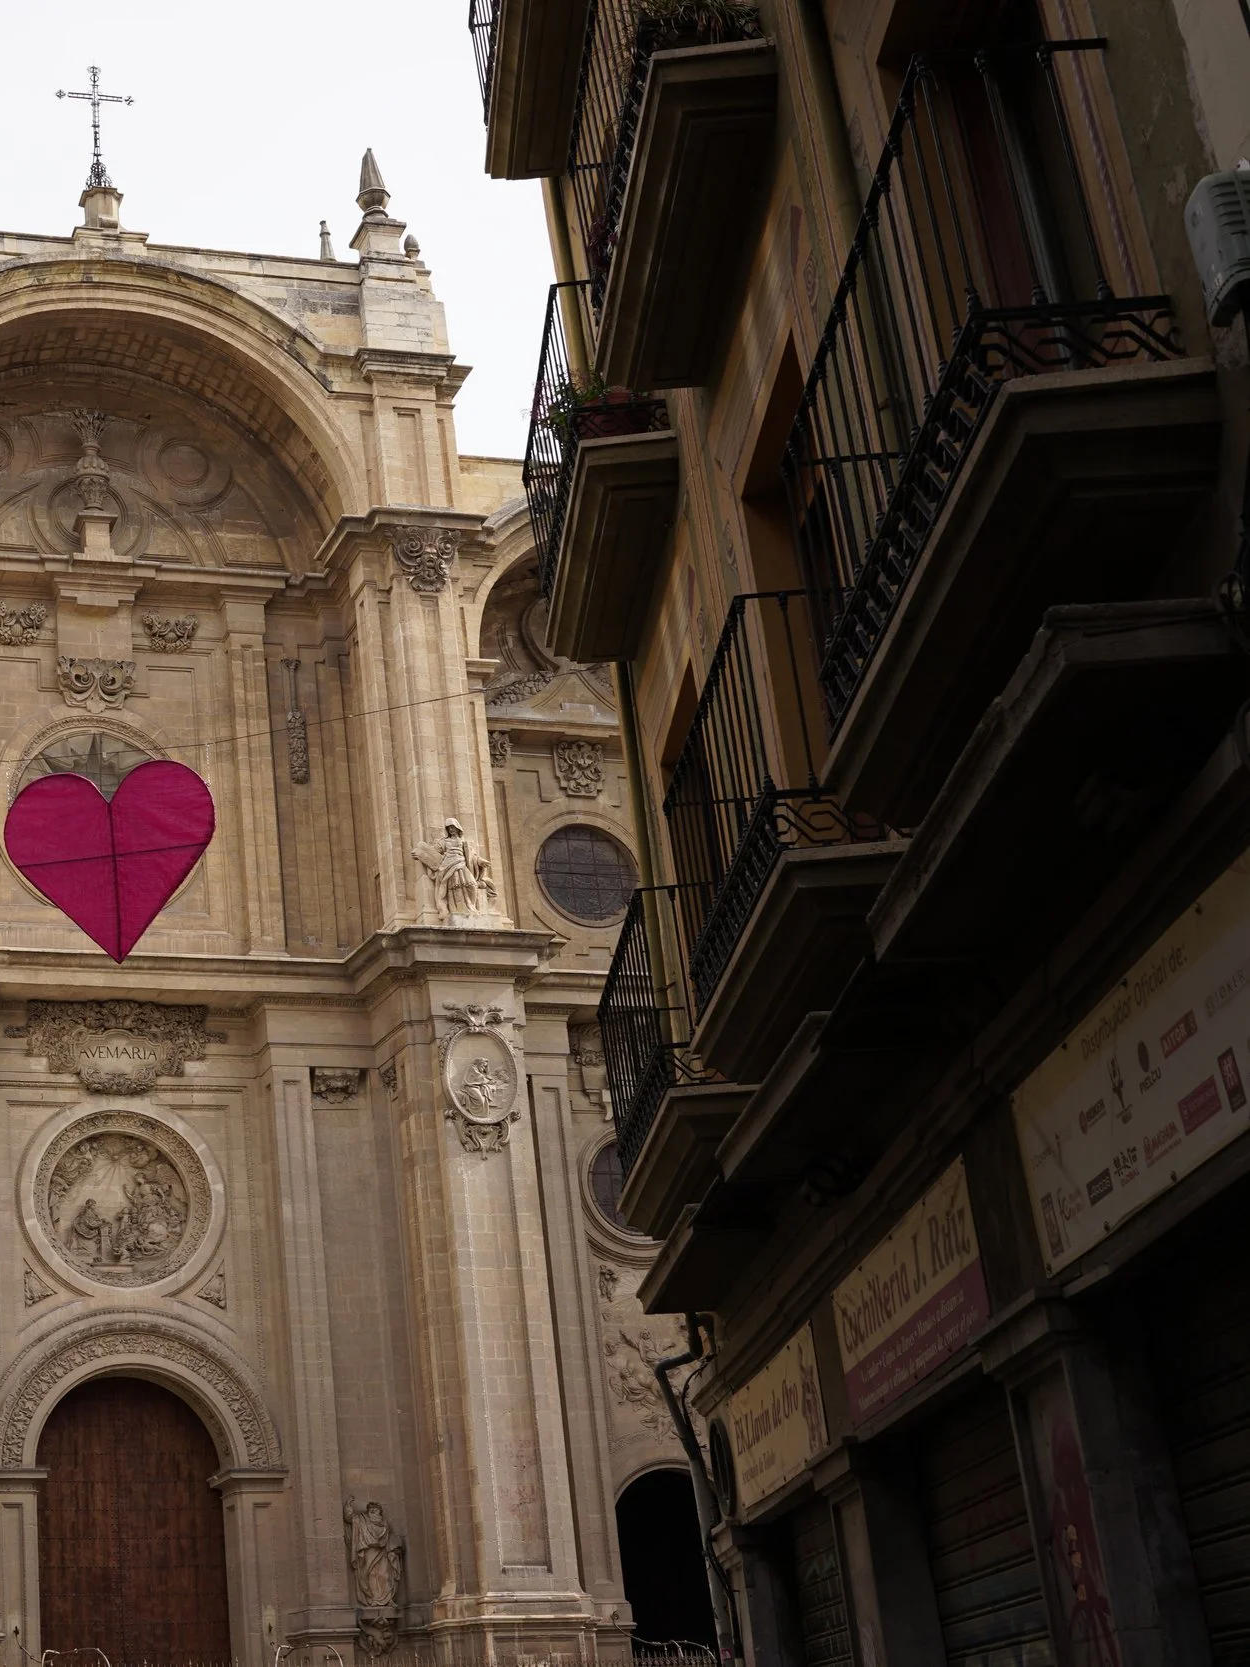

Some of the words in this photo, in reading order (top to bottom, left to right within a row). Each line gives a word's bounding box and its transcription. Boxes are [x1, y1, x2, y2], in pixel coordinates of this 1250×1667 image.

[1080, 995, 1132, 1061] Distribuidor
[1133, 955, 1168, 1008] Oficial
[1169, 943, 1188, 974] de:
[842, 1252, 911, 1354] Cuchillería
[911, 1231, 927, 1295] J.
[771, 1388, 783, 1430] de
[782, 1379, 800, 1419] Oro
